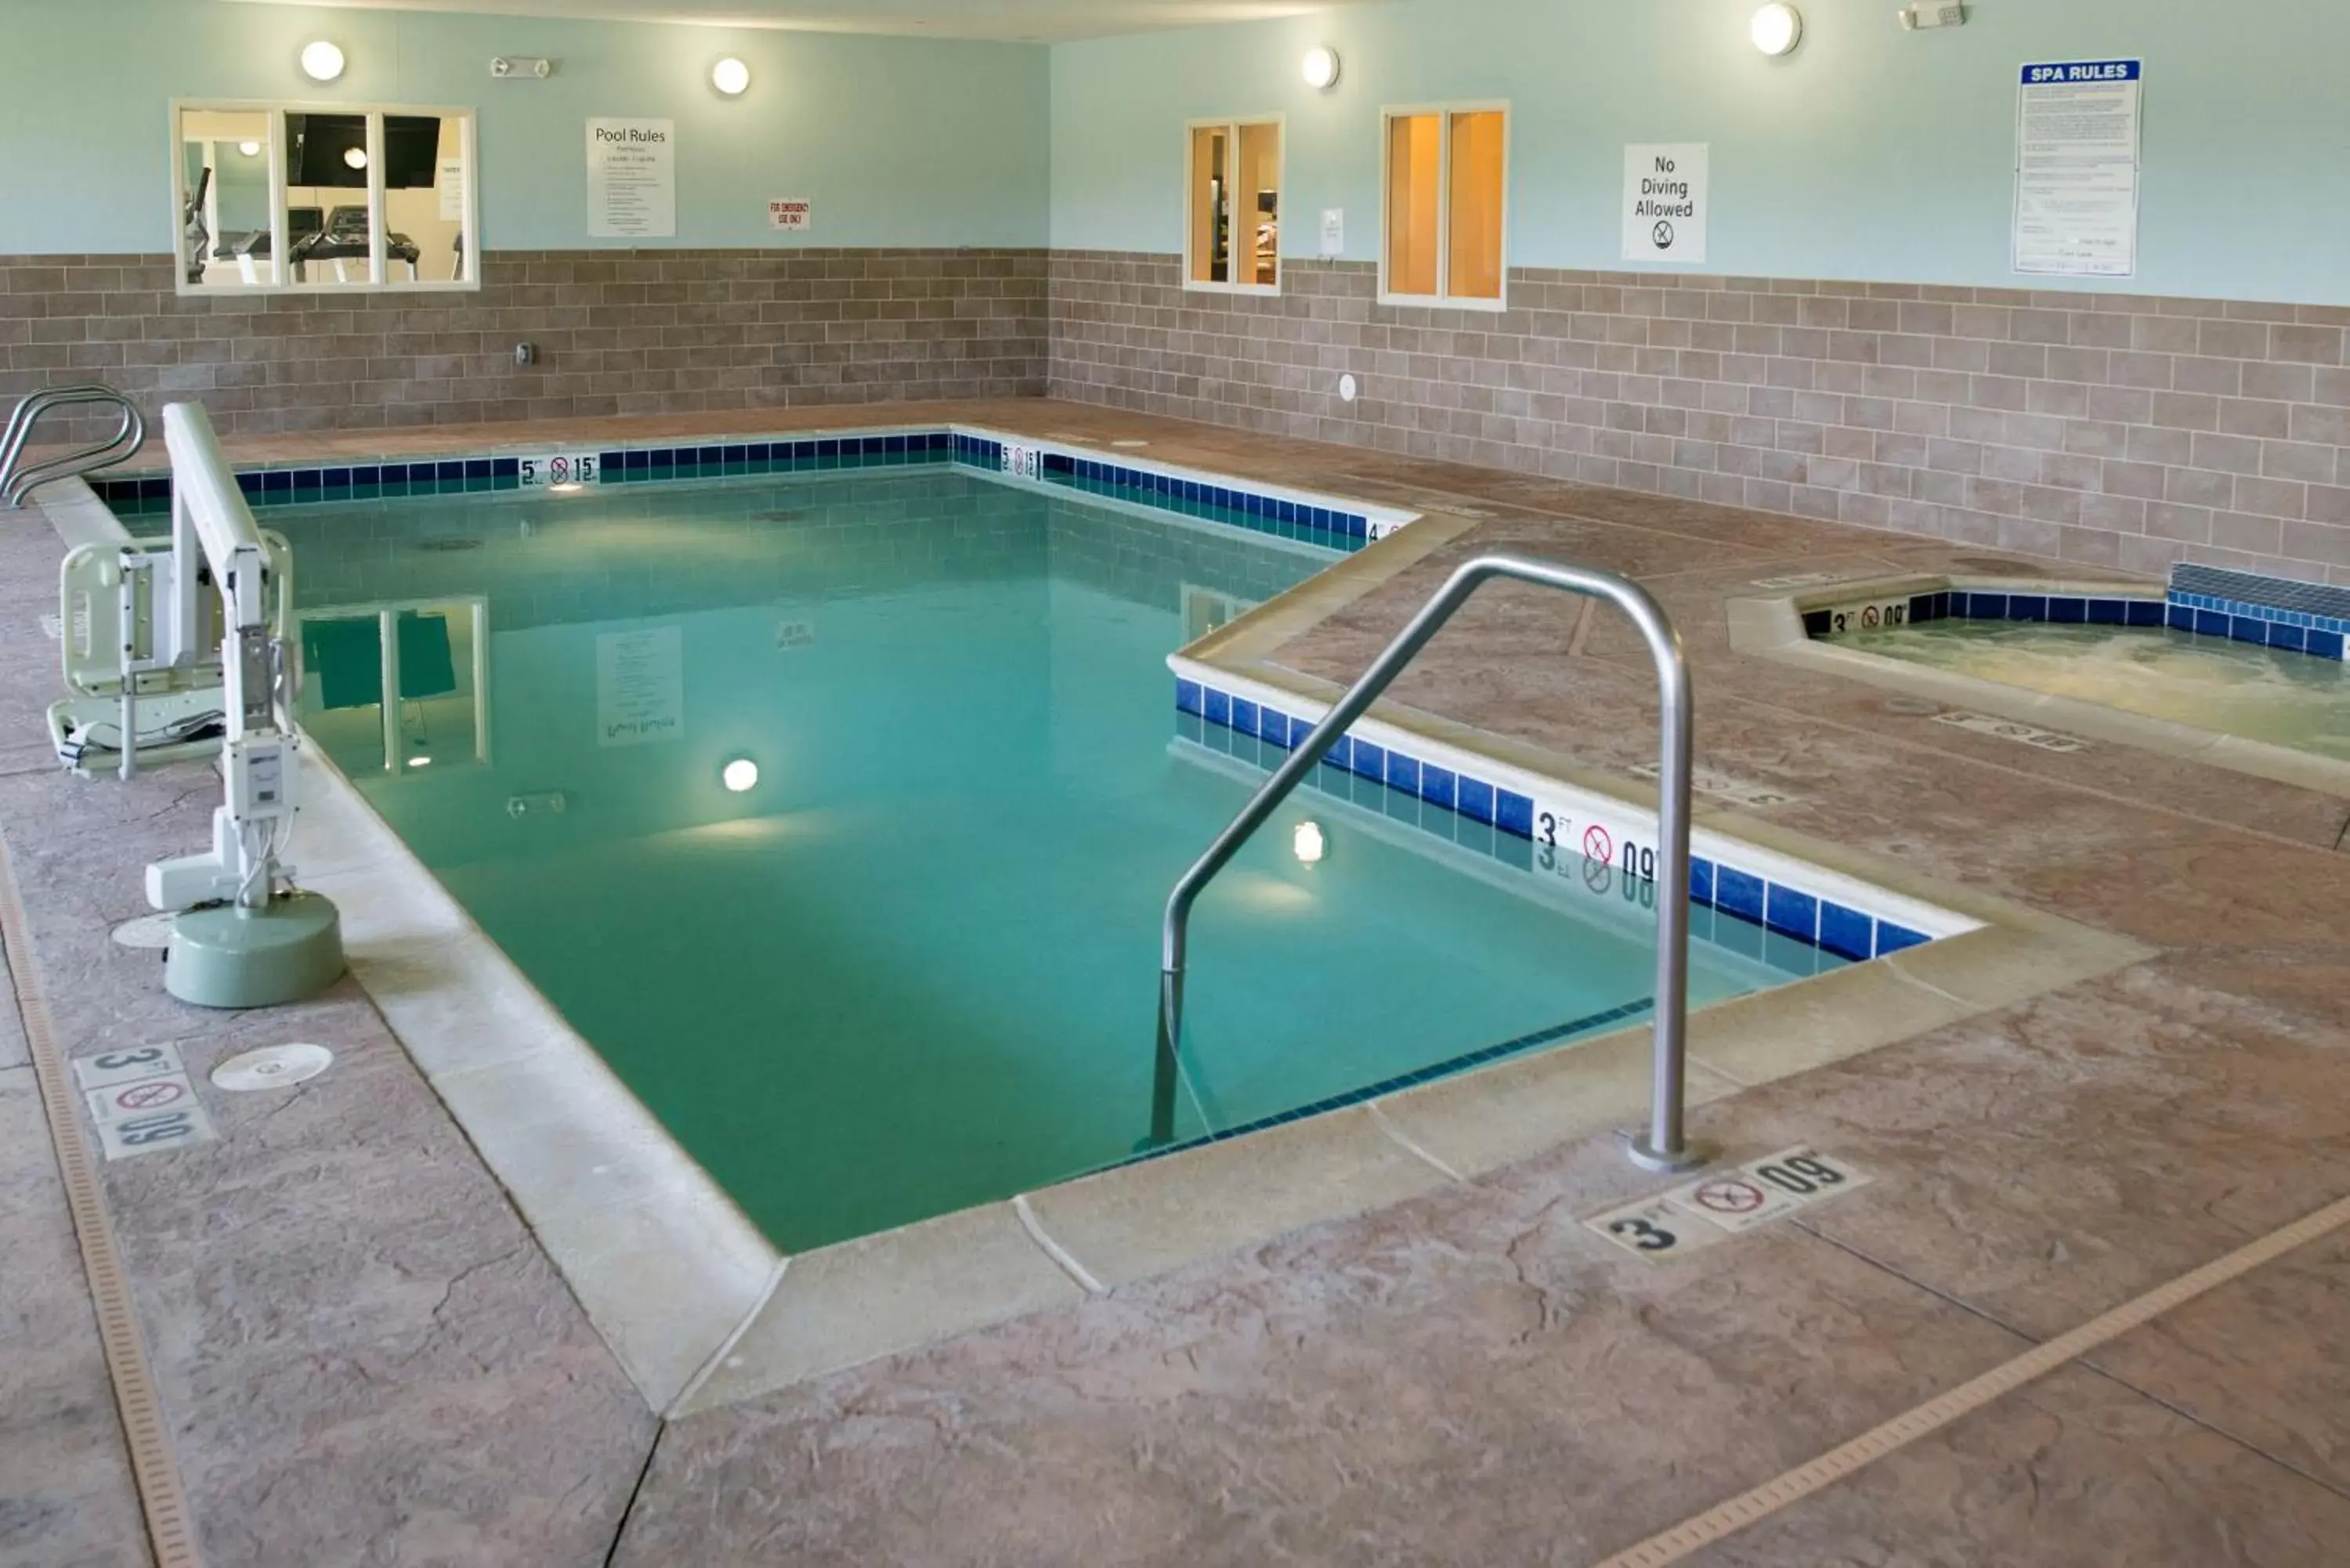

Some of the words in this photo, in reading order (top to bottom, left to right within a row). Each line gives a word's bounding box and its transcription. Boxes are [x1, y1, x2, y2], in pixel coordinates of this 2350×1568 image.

[2030, 67, 2064, 81] SPA
[2070, 63, 2128, 79] RULES
[596, 128, 626, 142] Pool
[630, 128, 665, 143] Rules
[1655, 156, 1675, 173] No
[1641, 178, 1688, 200] Diving
[771, 203, 779, 212] FOR
[1635, 200, 1693, 218] Allowed
[1538, 811, 1556, 846] 3
[94, 1048, 163, 1069] 3
[117, 1112, 193, 1145] 09
[1609, 1218, 1676, 1251] 3
[1756, 1157, 1846, 1194] 09
